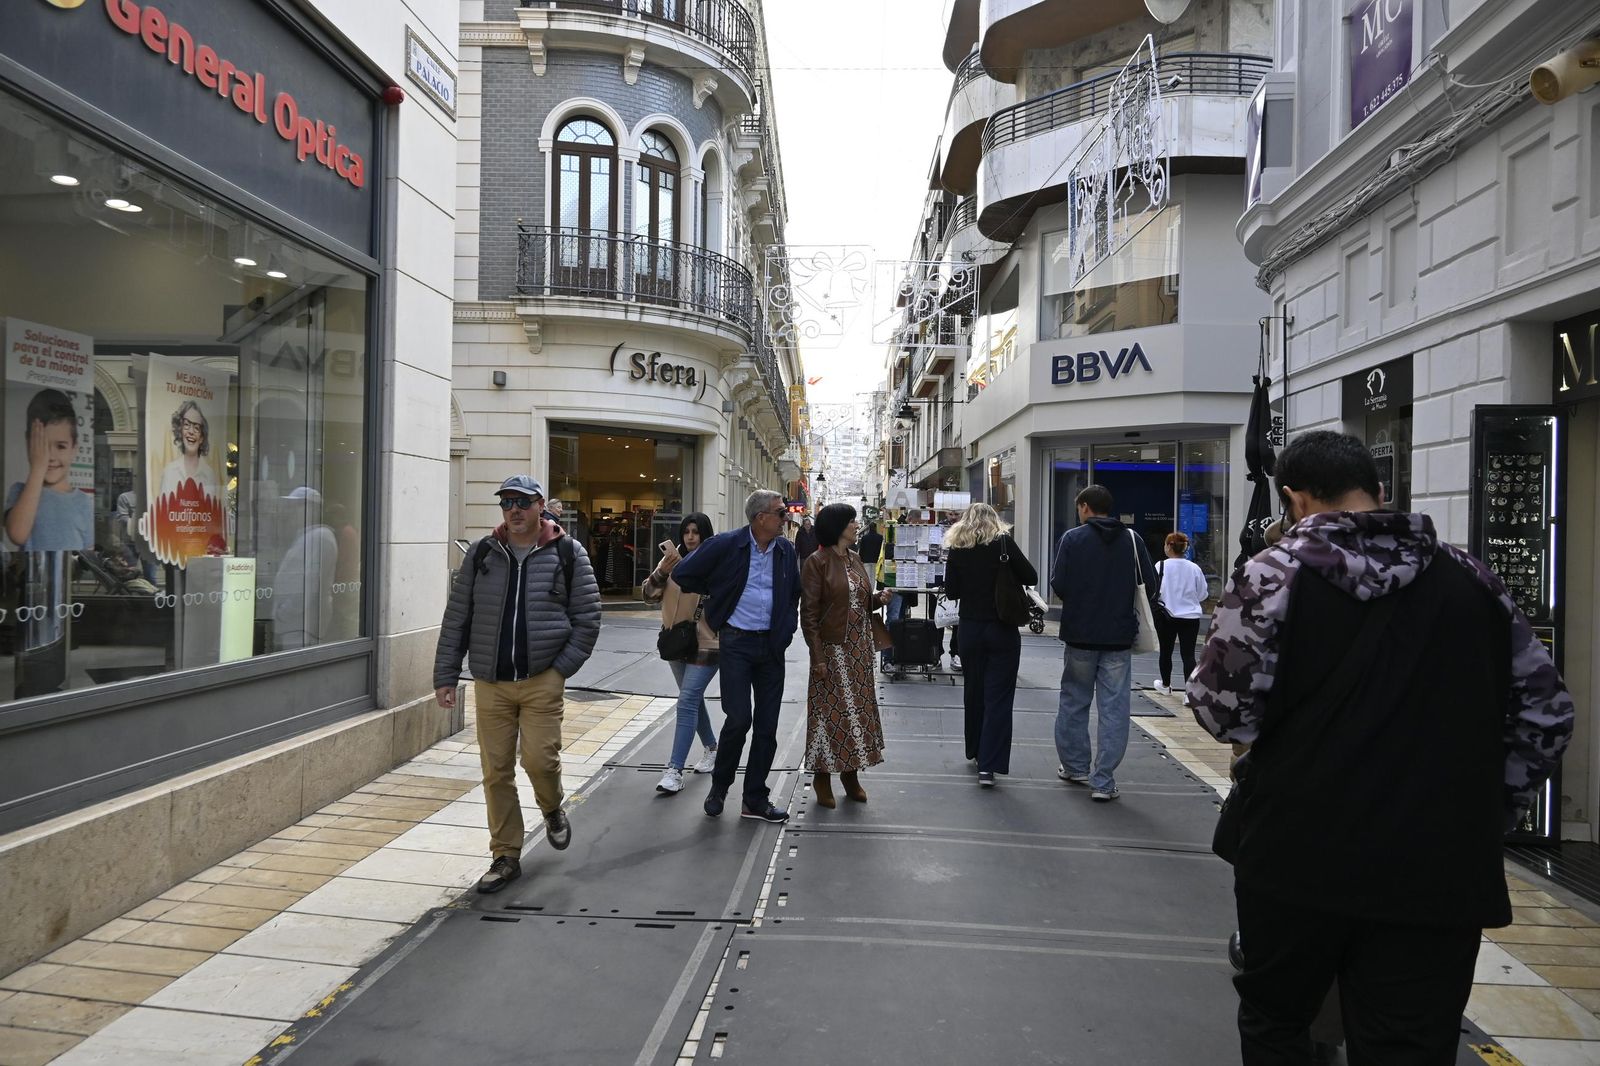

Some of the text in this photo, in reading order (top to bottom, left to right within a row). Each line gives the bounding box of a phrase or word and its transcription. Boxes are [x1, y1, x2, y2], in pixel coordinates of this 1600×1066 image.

[416, 60, 450, 101] PALACIO
[105, 0, 364, 188] General Optica
[24, 329, 80, 351] Soluciones
[13, 342, 89, 365] para el control
[20, 354, 33, 366] de
[36, 357, 47, 368] la
[1052, 342, 1153, 385] BBVA
[176, 371, 207, 386] MEJORA
[166, 382, 214, 400] TU AUDICIÓN
[1370, 446, 1393, 457] OFERTA
[169, 508, 212, 524] audífonos
